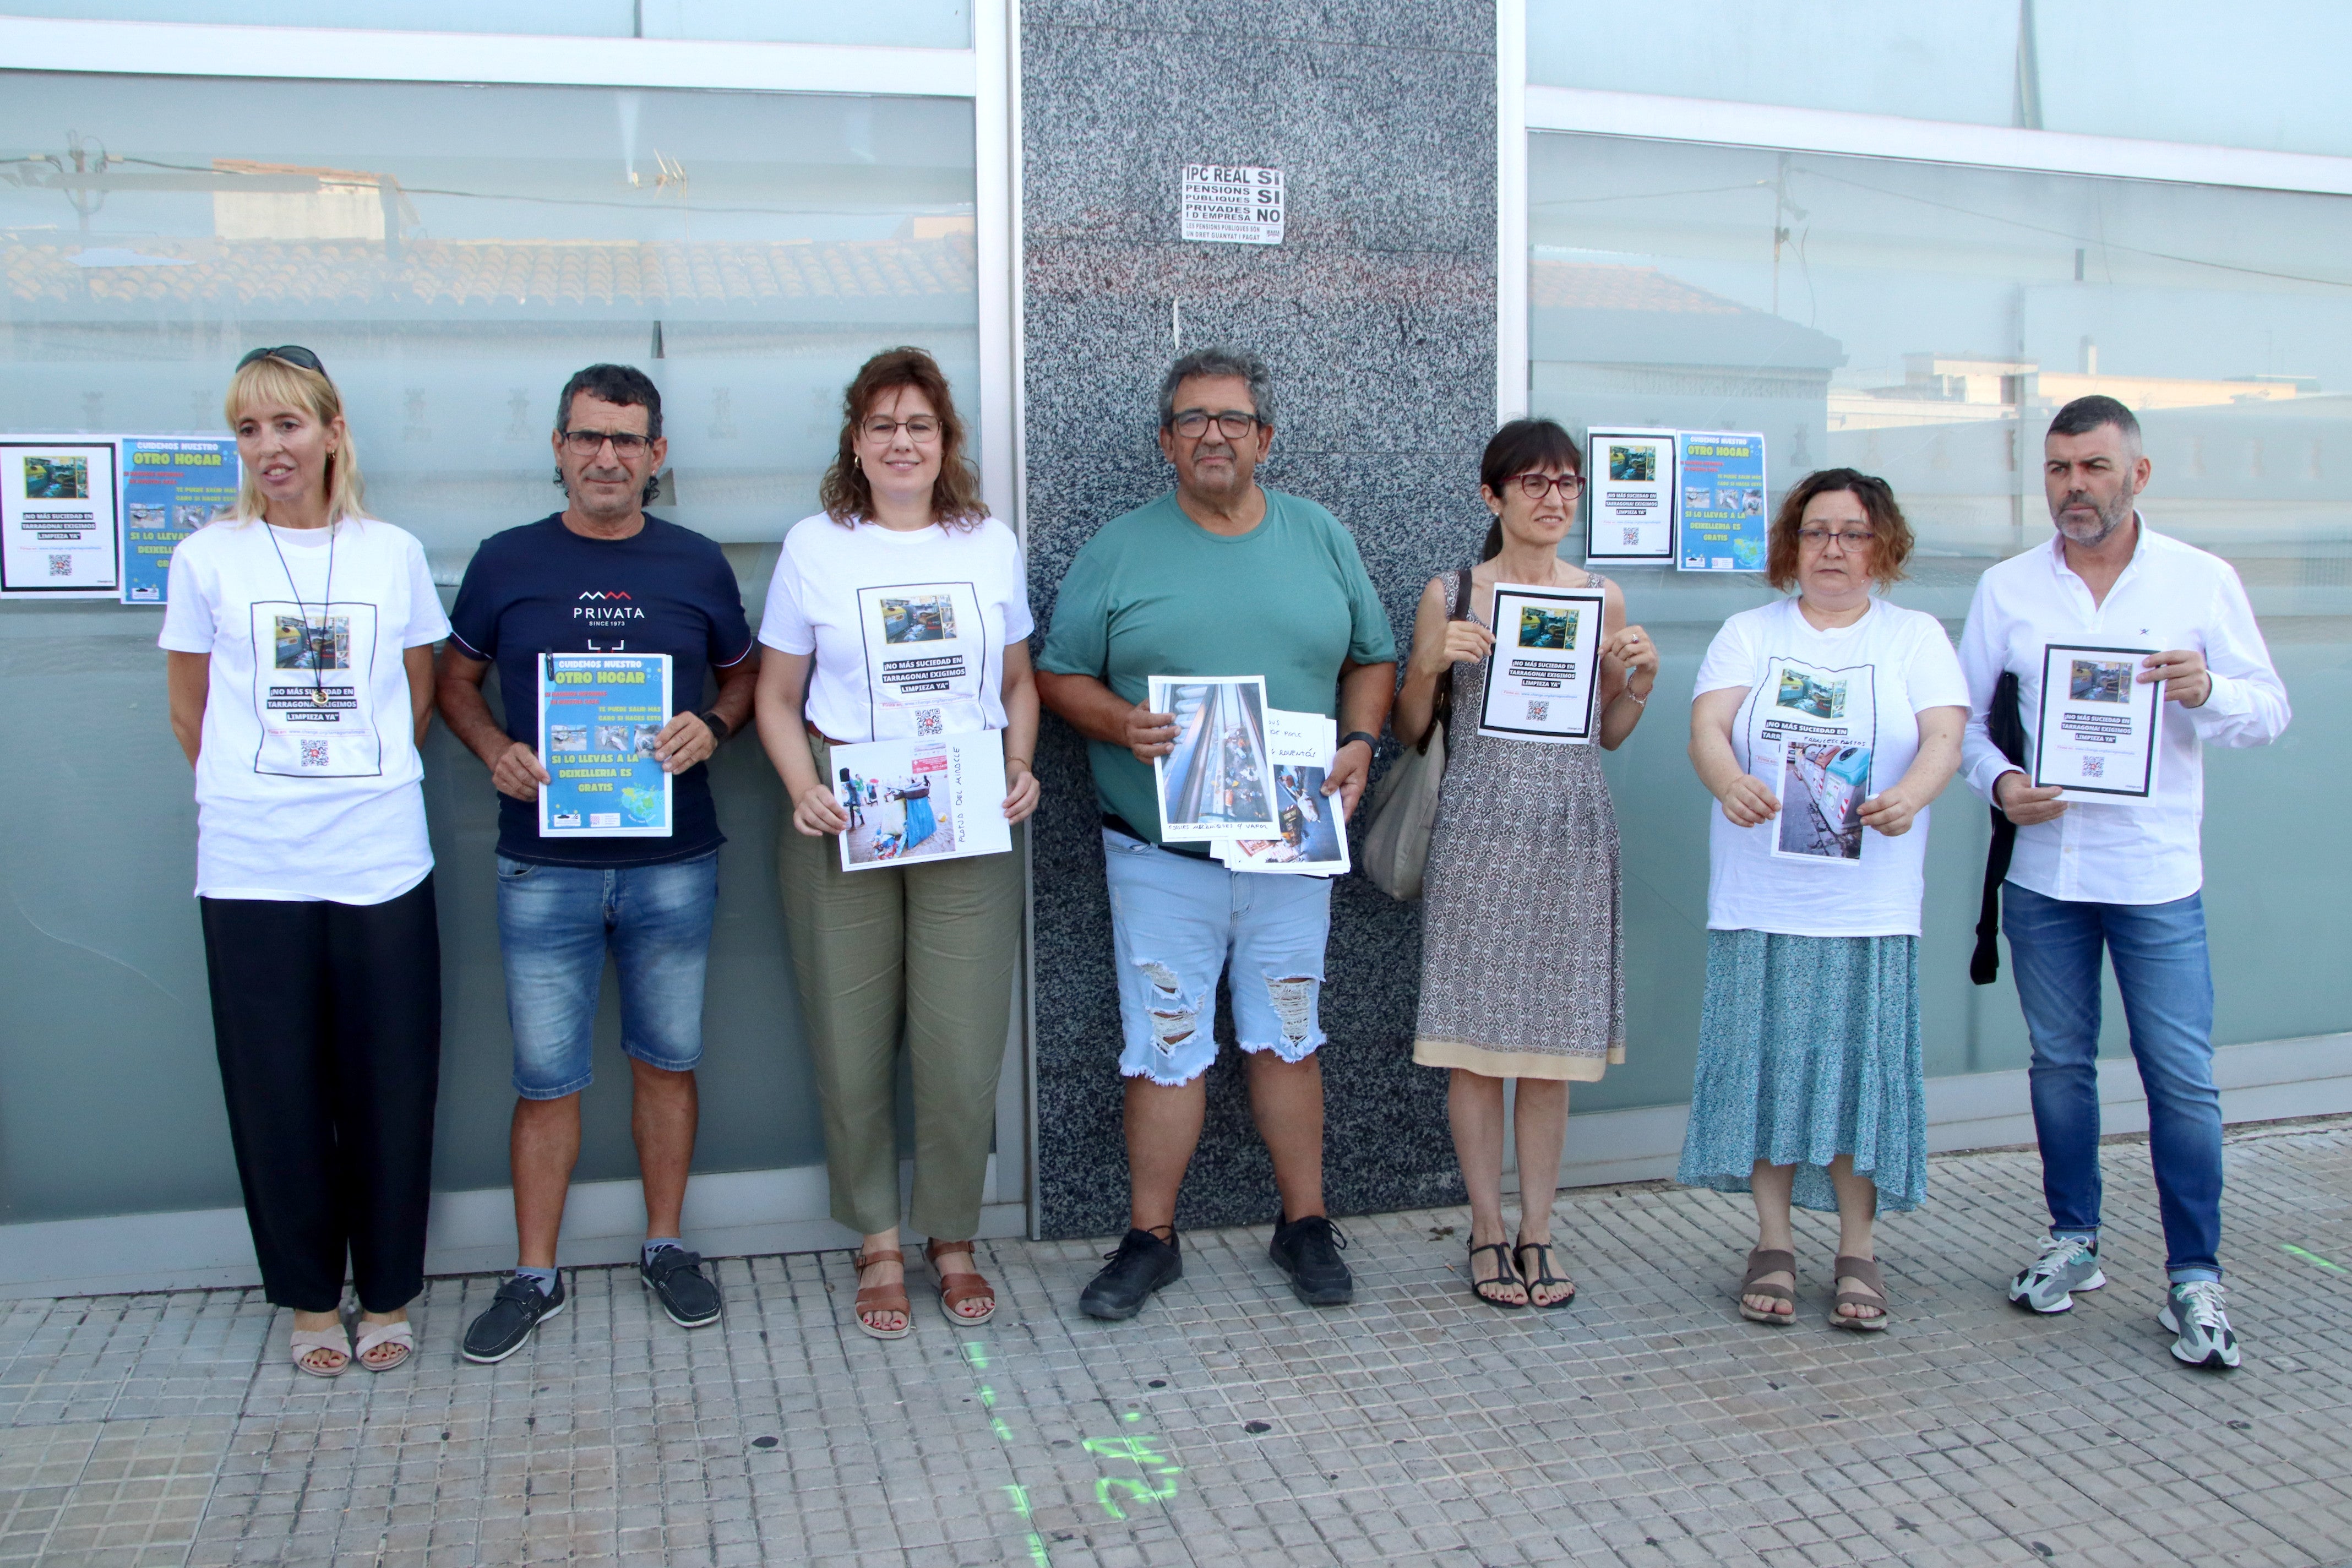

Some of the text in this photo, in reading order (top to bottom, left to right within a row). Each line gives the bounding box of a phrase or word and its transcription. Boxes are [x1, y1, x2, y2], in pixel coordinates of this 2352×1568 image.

[1186, 167, 1280, 185] IPC REAL SI
[1186, 185, 1280, 204] PENSIONS SI
[1186, 194, 1250, 203] PÚBLIQUES
[1186, 204, 1280, 222] PRIVADES NO
[1687, 445, 1750, 457] OTRO HOGAR
[133, 453, 221, 466] OTRO HOGAR
[130, 532, 140, 540] SI
[143, 532, 154, 540] LO
[573, 608, 645, 618] PRIVATA
[916, 658, 951, 667] SUCIEDAD
[555, 671, 645, 684] OTRO HOGAR
[883, 669, 965, 682] TARRAGONA! EXIGIMOS
[1799, 725, 1836, 734] SUCIEDAD
[552, 754, 639, 764] SI LO LLEVAS A LA
[559, 768, 632, 778] DEIXELLERIA ES
[578, 783, 613, 792] GRATIS
